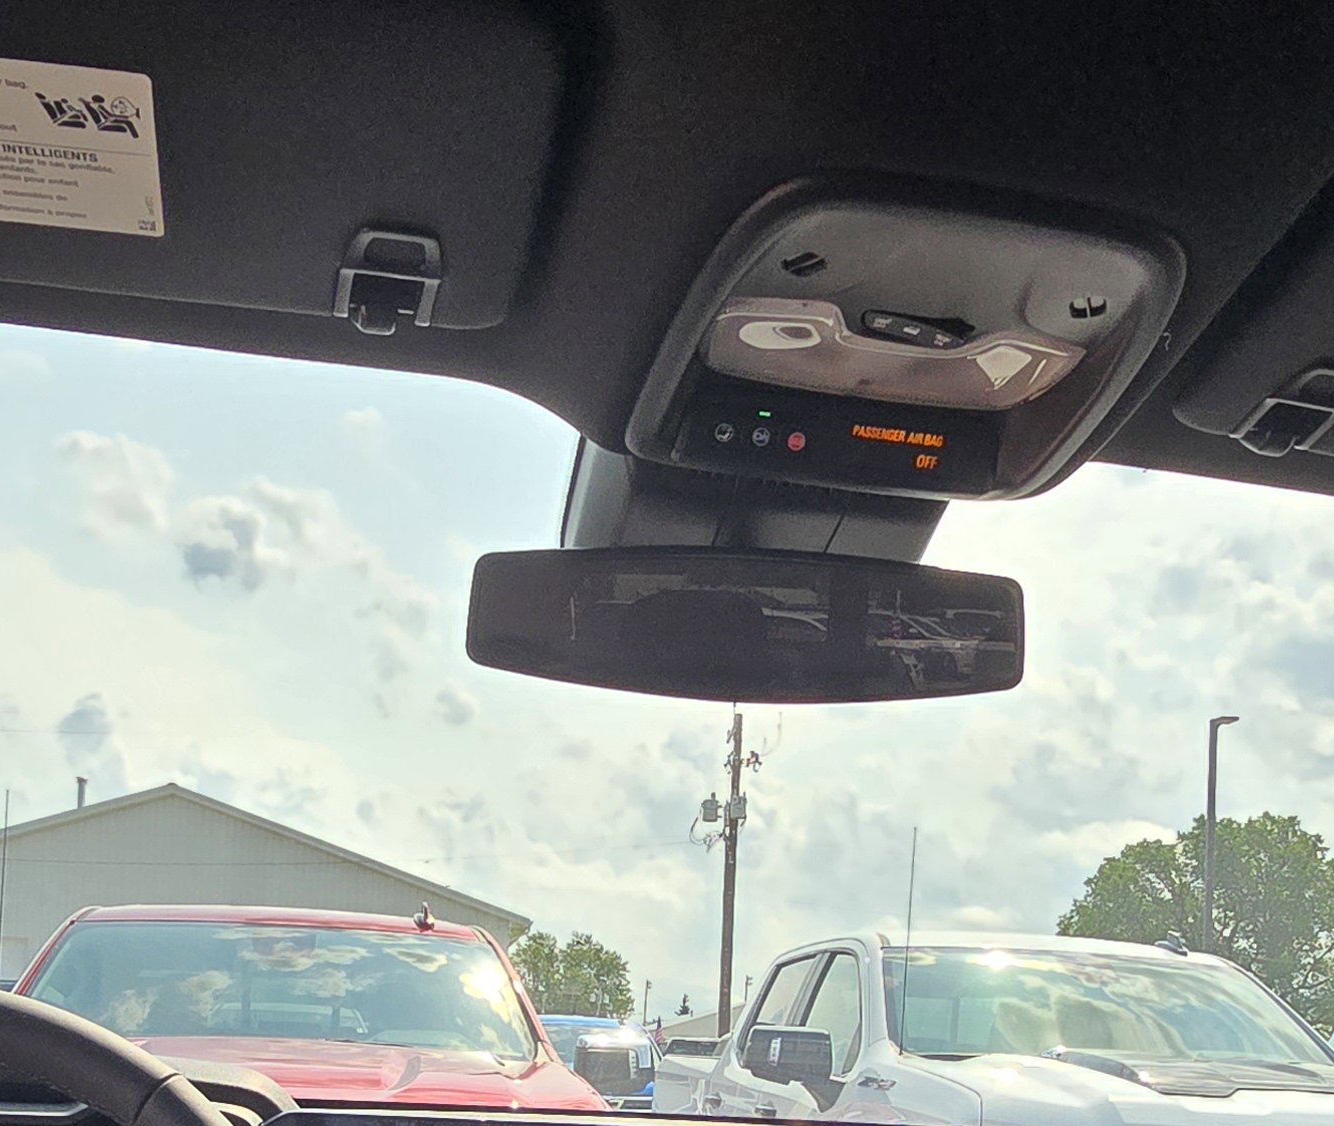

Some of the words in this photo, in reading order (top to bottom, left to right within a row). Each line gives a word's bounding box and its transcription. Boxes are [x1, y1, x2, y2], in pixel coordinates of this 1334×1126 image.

[1, 143, 98, 163] INTELLIGENTS
[852, 424, 906, 442] PASSENGER
[916, 454, 938, 469] OFF
